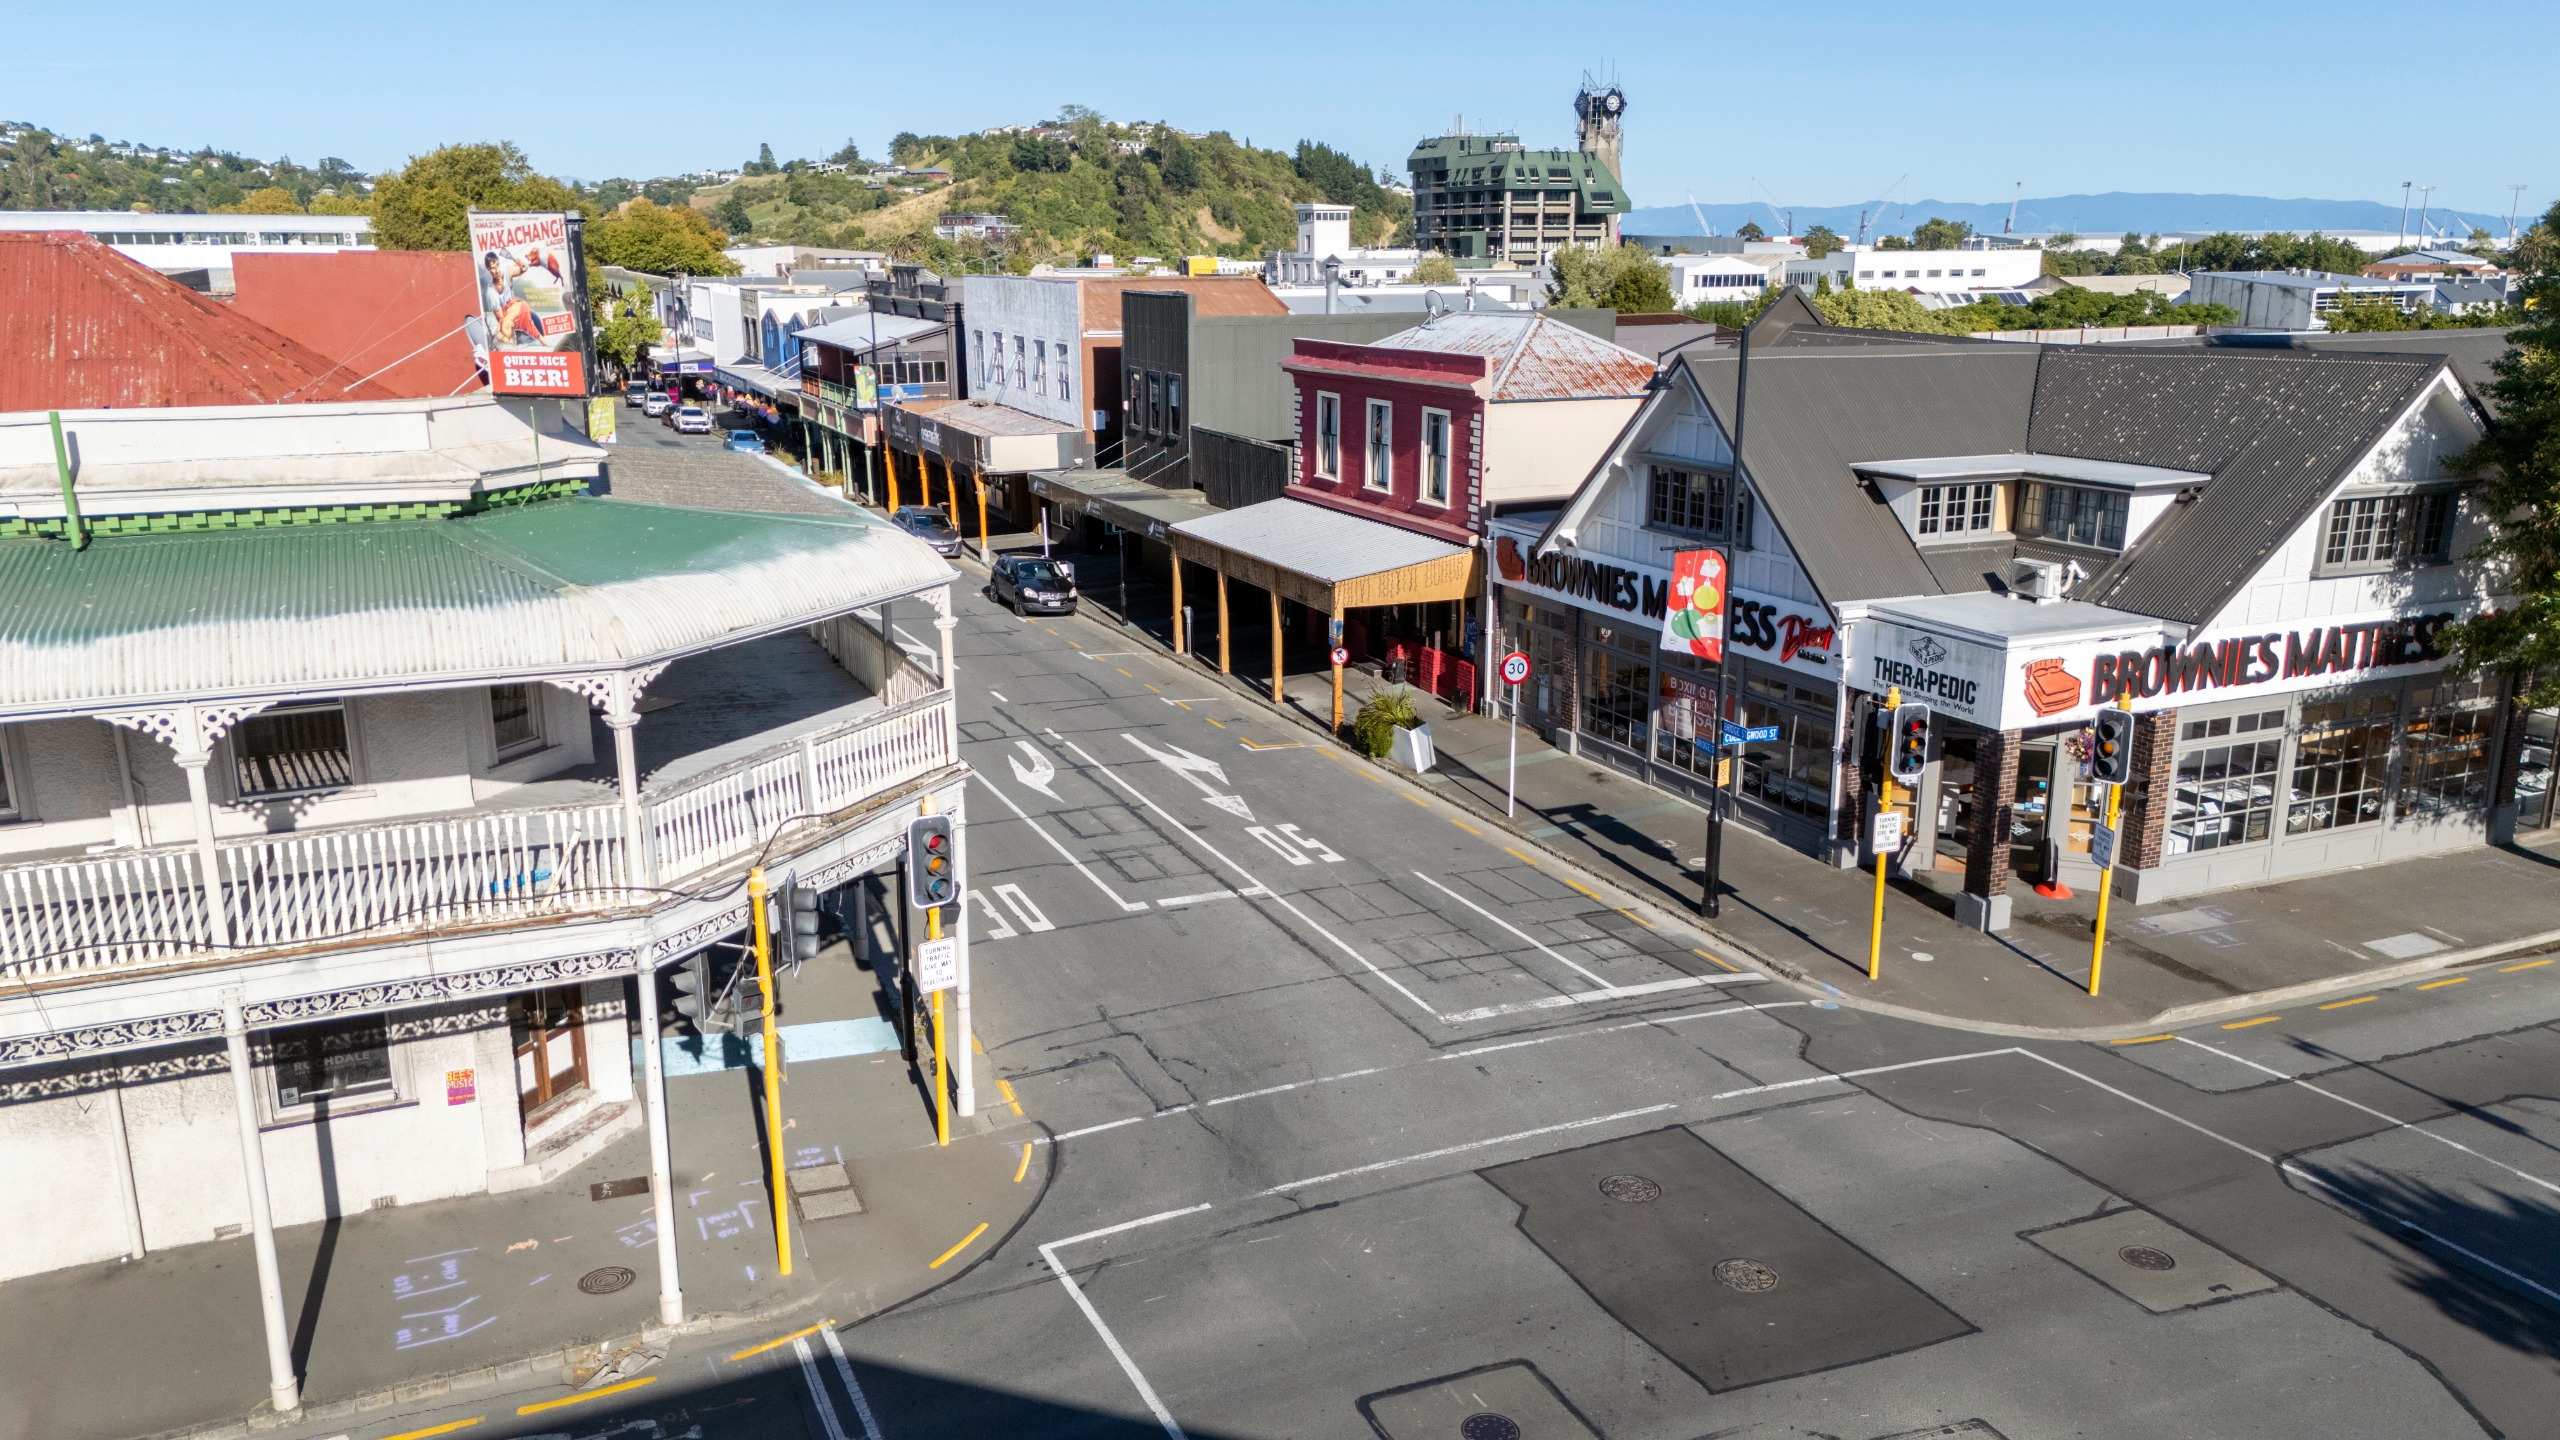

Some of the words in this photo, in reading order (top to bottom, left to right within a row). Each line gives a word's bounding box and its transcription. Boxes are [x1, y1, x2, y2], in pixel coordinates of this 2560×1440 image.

[477, 218, 564, 251] WAKACHANGI
[503, 355, 537, 367] QUITE
[539, 356, 567, 366] NICE
[505, 369, 569, 387] BEER!
[1527, 544, 1638, 612] BROWNIES
[2090, 633, 2282, 705] BROWNIES
[2282, 612, 2454, 680] MATTRESS
[1508, 662, 1525, 675] 30
[1873, 679, 1884, 689] The
[1886, 683, 1911, 697] Mress
[1913, 691, 1939, 707] Sleeping
[1940, 698, 1951, 709] the
[1953, 702, 1974, 715] World
[1723, 722, 1740, 737] BRIDGE
[1725, 729, 1767, 742] COLGWOOD
[1769, 728, 1777, 738] ST
[966, 883, 1056, 940] 30
[925, 944, 951, 955] TURNING
[926, 951, 951, 962] TRAFFIC
[924, 962, 937, 971] GIVE
[923, 975, 956, 987] PEDESTRIANS
[445, 1068, 473, 1081] BEES
[446, 1078, 474, 1089] MUSIC
